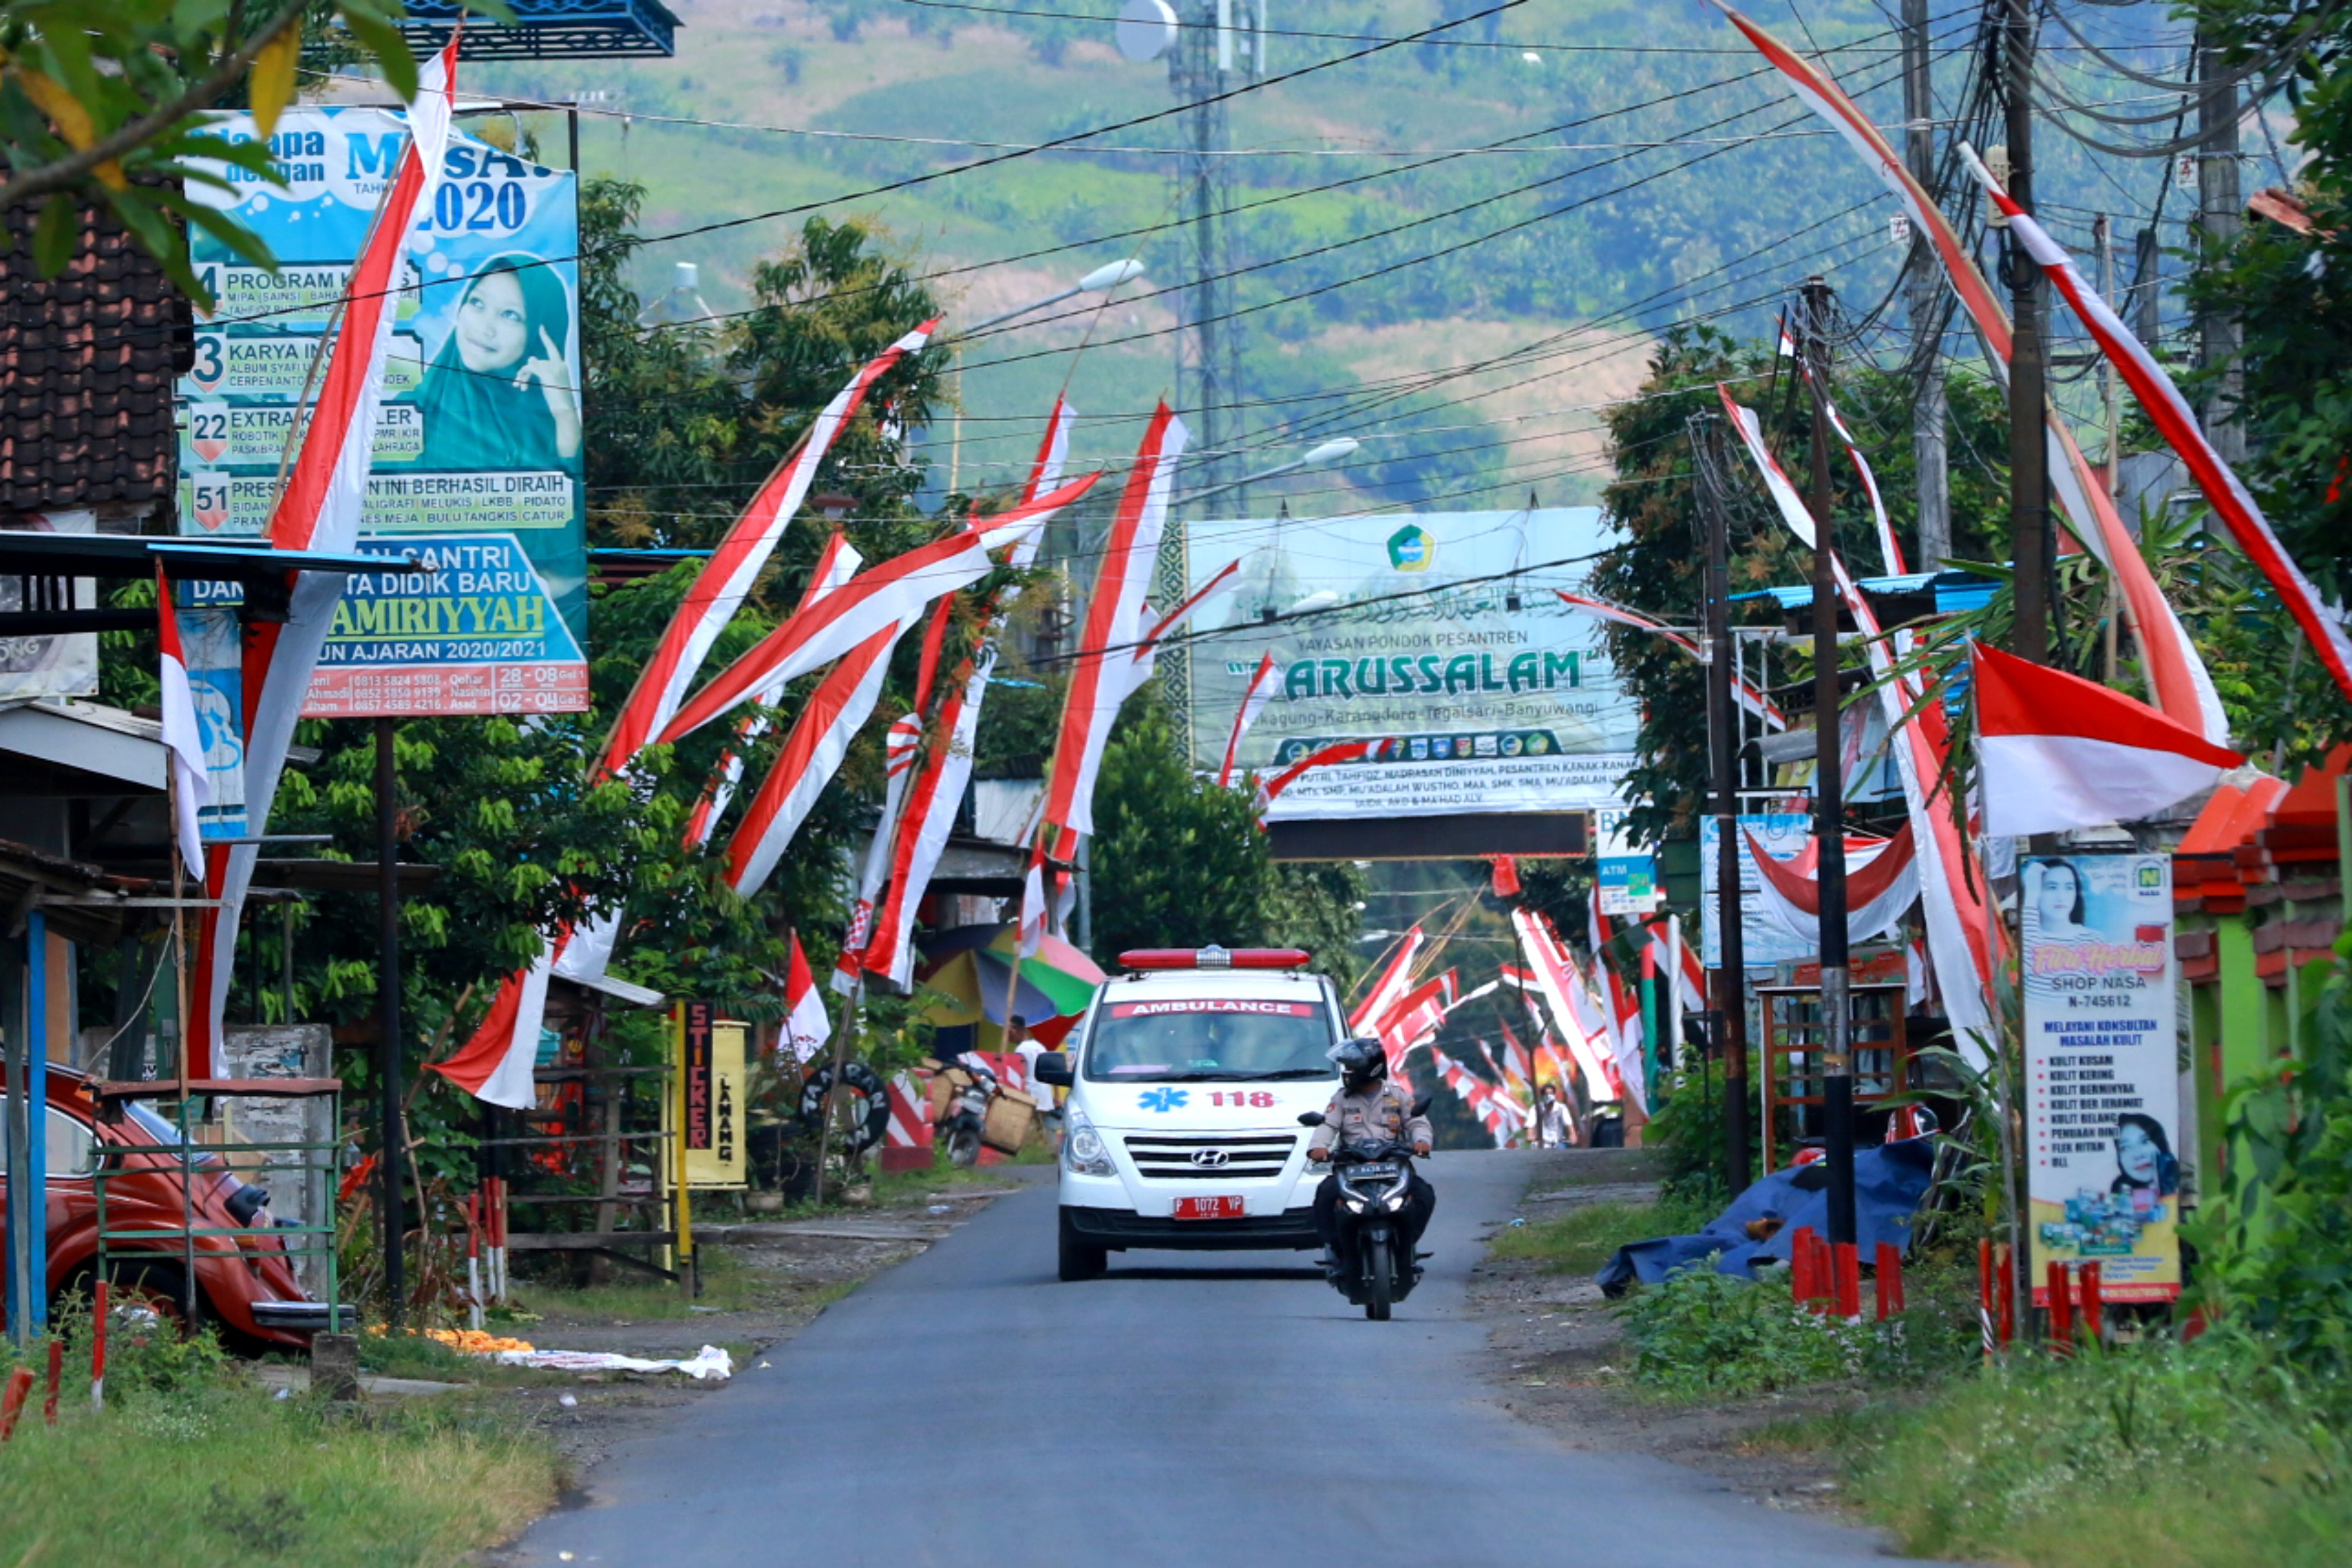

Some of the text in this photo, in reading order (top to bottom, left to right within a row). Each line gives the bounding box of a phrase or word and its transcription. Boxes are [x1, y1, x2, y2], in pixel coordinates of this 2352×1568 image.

[416, 181, 526, 231] 020
[228, 272, 333, 289] PROGRAM
[194, 336, 223, 383] 3
[229, 343, 300, 360] KARYA
[230, 363, 268, 373] ALBUM
[230, 376, 273, 386] CERPEN
[193, 414, 226, 440] 22
[232, 411, 294, 427] EXTRA
[232, 431, 278, 441] ROBOTIK
[372, 443, 420, 453] LAHRAGA
[385, 479, 407, 495] INI
[412, 477, 500, 494] BERHASIL
[505, 476, 564, 493] DIRAIH
[196, 487, 227, 511] 51
[233, 502, 268, 512] BIDAN
[422, 497, 472, 509] MELUKIS
[523, 496, 566, 507] PIDATO
[385, 513, 419, 524] MEJA
[427, 511, 461, 523] BULU
[464, 511, 517, 522] TANGKIS
[522, 510, 565, 521] CATUR
[382, 573, 450, 595] DIDIK
[458, 570, 531, 594] BARU
[329, 595, 544, 635] AMIRIYYAH
[1297, 630, 1528, 651] YAYASAN PONDOK PESANTREN
[352, 642, 440, 660] AJARAN
[446, 641, 546, 659] 2020/2021
[500, 668, 522, 683] 28
[534, 667, 558, 683] 08
[1227, 650, 1601, 702] "ARUSSALAM"
[499, 693, 522, 708] 02
[534, 691, 558, 707] 04
[1499, 763, 1560, 774] PESANTREN
[1602, 864, 1628, 876] ATM
[2052, 975, 2147, 991] SHOP NASA
[1131, 1000, 1292, 1015] AMBULANCE
[2069, 995, 2132, 1008] N-745612
[2044, 1019, 2158, 1033] MELAYANI KONSULTAN
[2060, 1034, 2143, 1047] MASALAH KULIT
[2049, 1056, 2078, 1066] KULIT
[688, 1004, 709, 1149] STICKER
[2049, 1069, 2115, 1081] KULIT KERING
[2049, 1085, 2078, 1095] KULIT
[1209, 1090, 1275, 1108] 118
[2049, 1099, 2078, 1110] KULIT
[2049, 1114, 2078, 1124] KULIT
[1176, 1198, 1183, 1212] P
[1194, 1197, 1220, 1212] 1072
